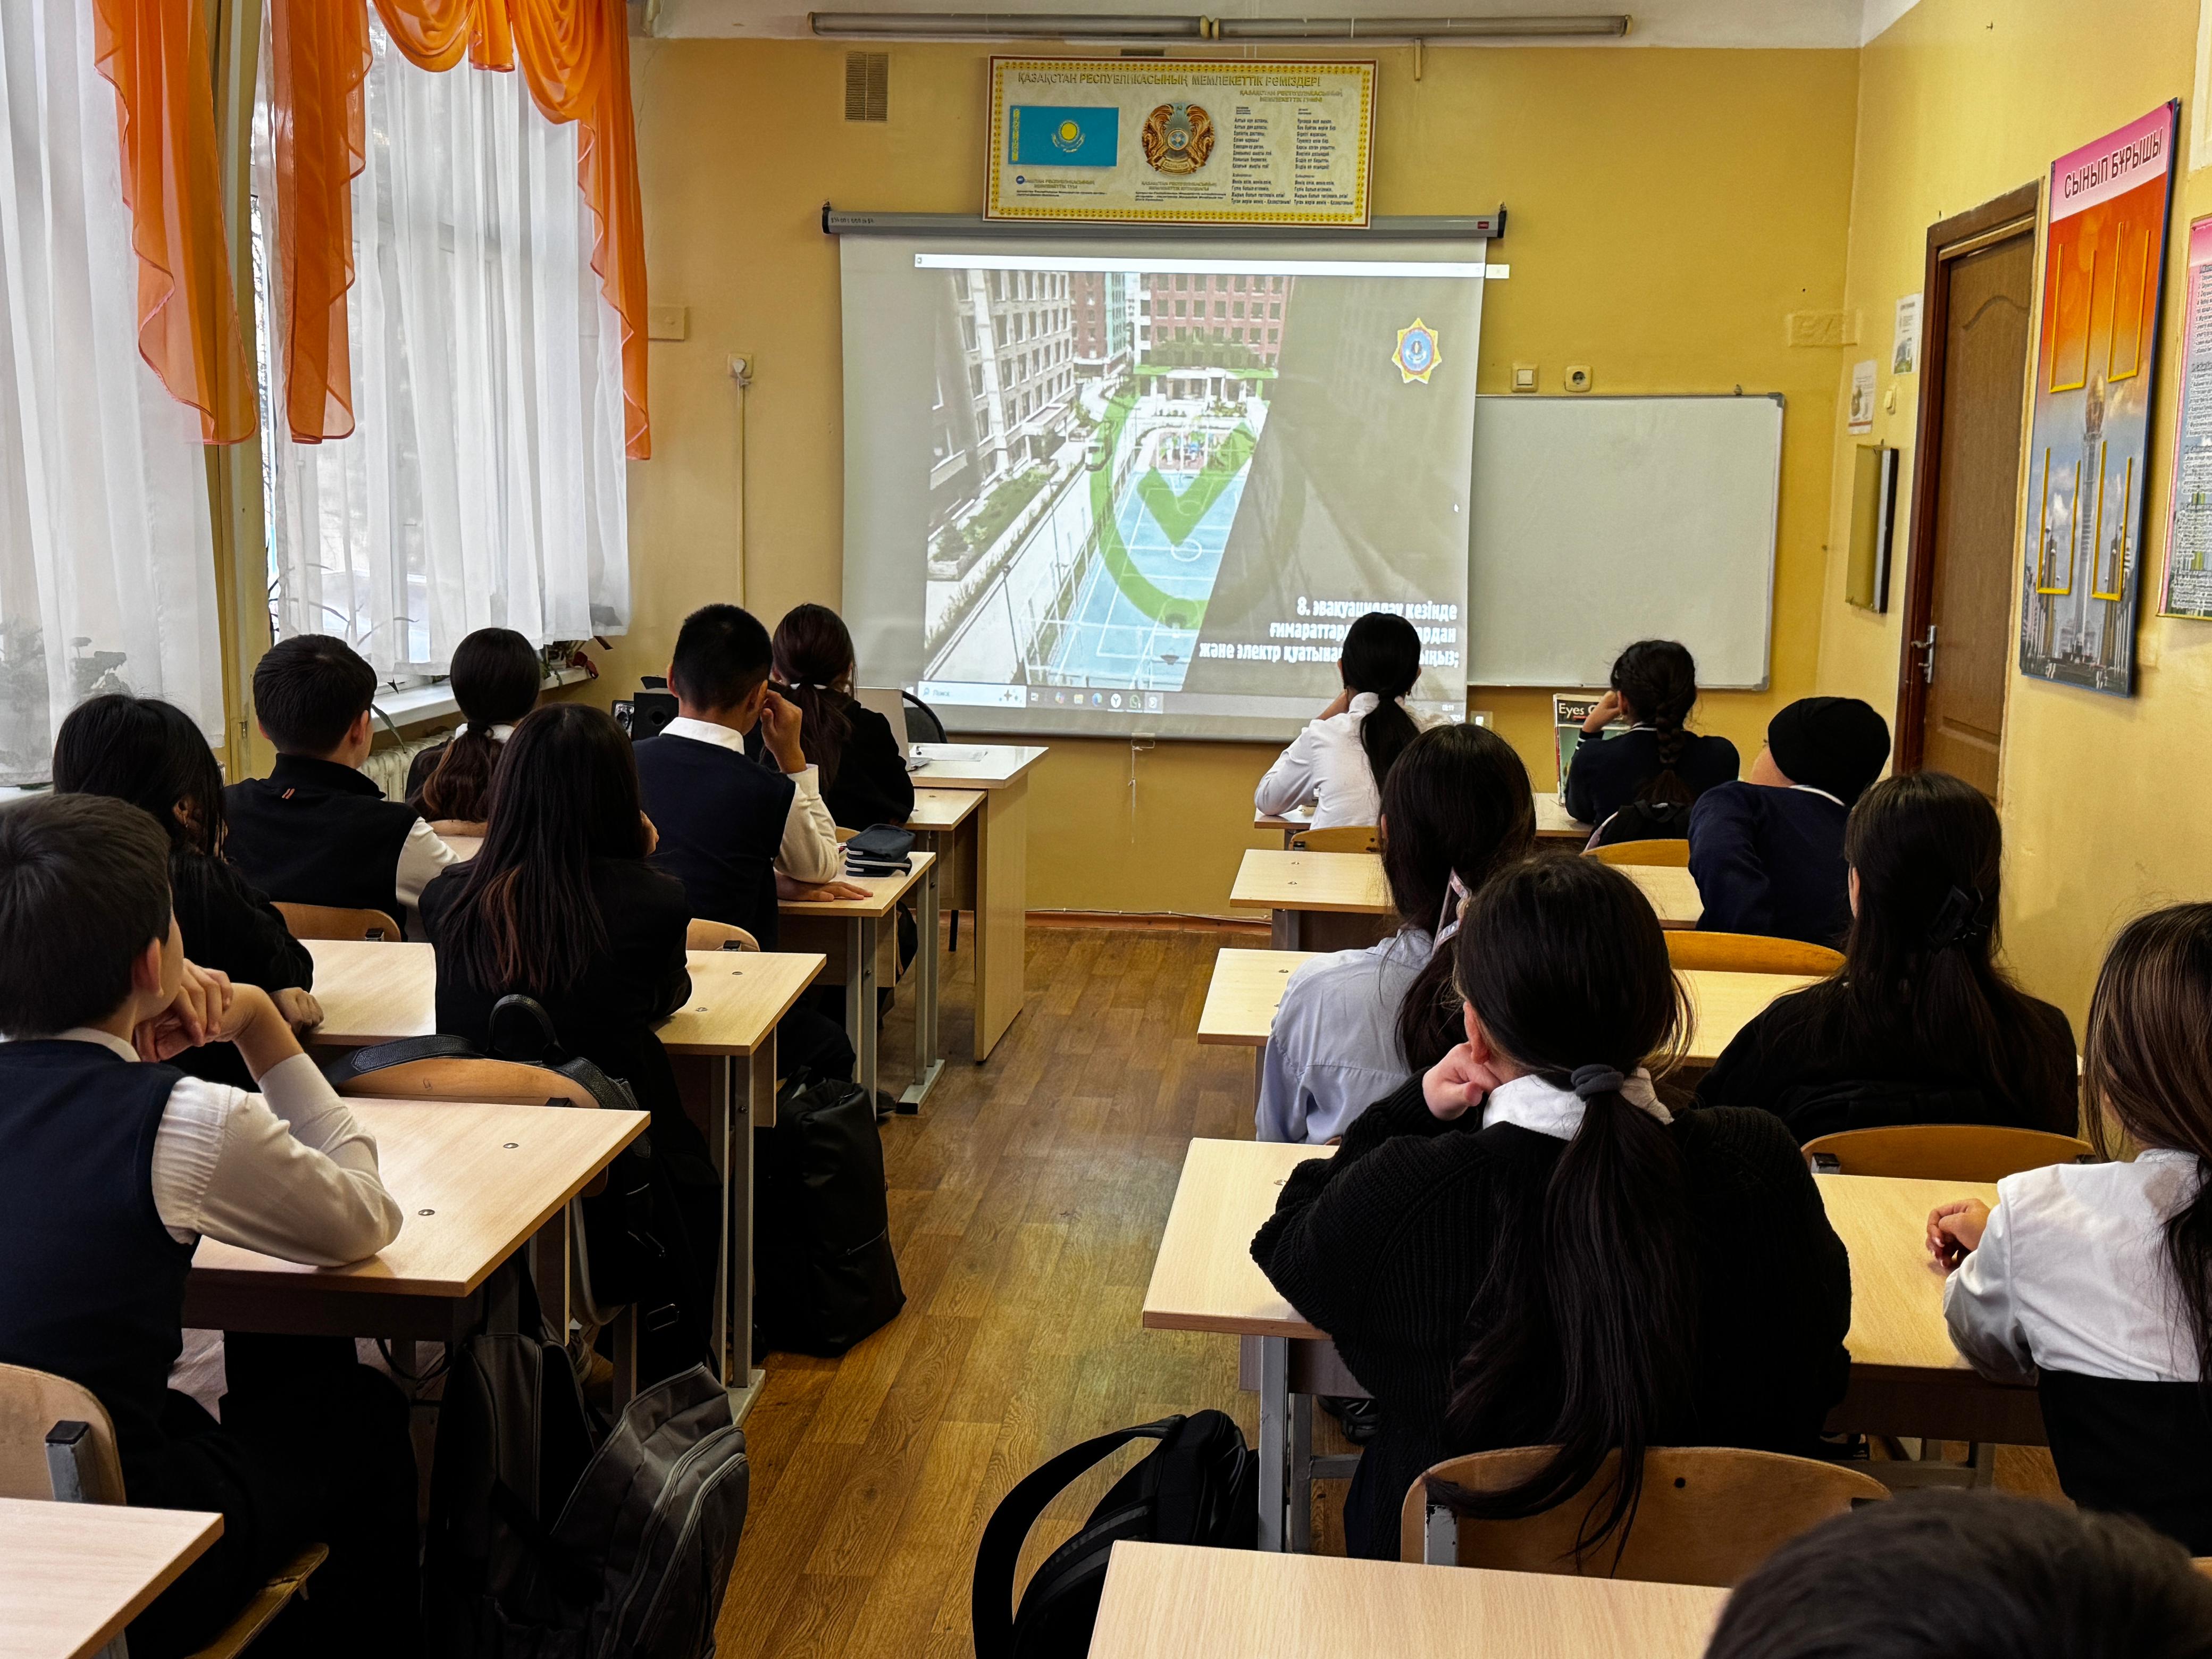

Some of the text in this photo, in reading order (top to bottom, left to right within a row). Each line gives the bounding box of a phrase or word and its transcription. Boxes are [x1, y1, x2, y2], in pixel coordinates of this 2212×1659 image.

[1018, 72, 1321, 88] ҚАЗАҚСТАН РЕСПУБЛИКАСЫНЫҢ МЕМЛЕКЕТТІК РӘМІЗДЕРІ
[2064, 128, 2163, 199] СЫНЫП БҰРЫШЫ
[1297, 596, 1310, 616] 8.
[1405, 600, 1457, 622] кезінде
[1270, 622, 1353, 641] ғимараттар
[1199, 642, 1234, 659] және
[1237, 643, 1281, 663] электр
[1283, 645, 1343, 663] қуатына
[1559, 703, 1585, 719] Eyes
